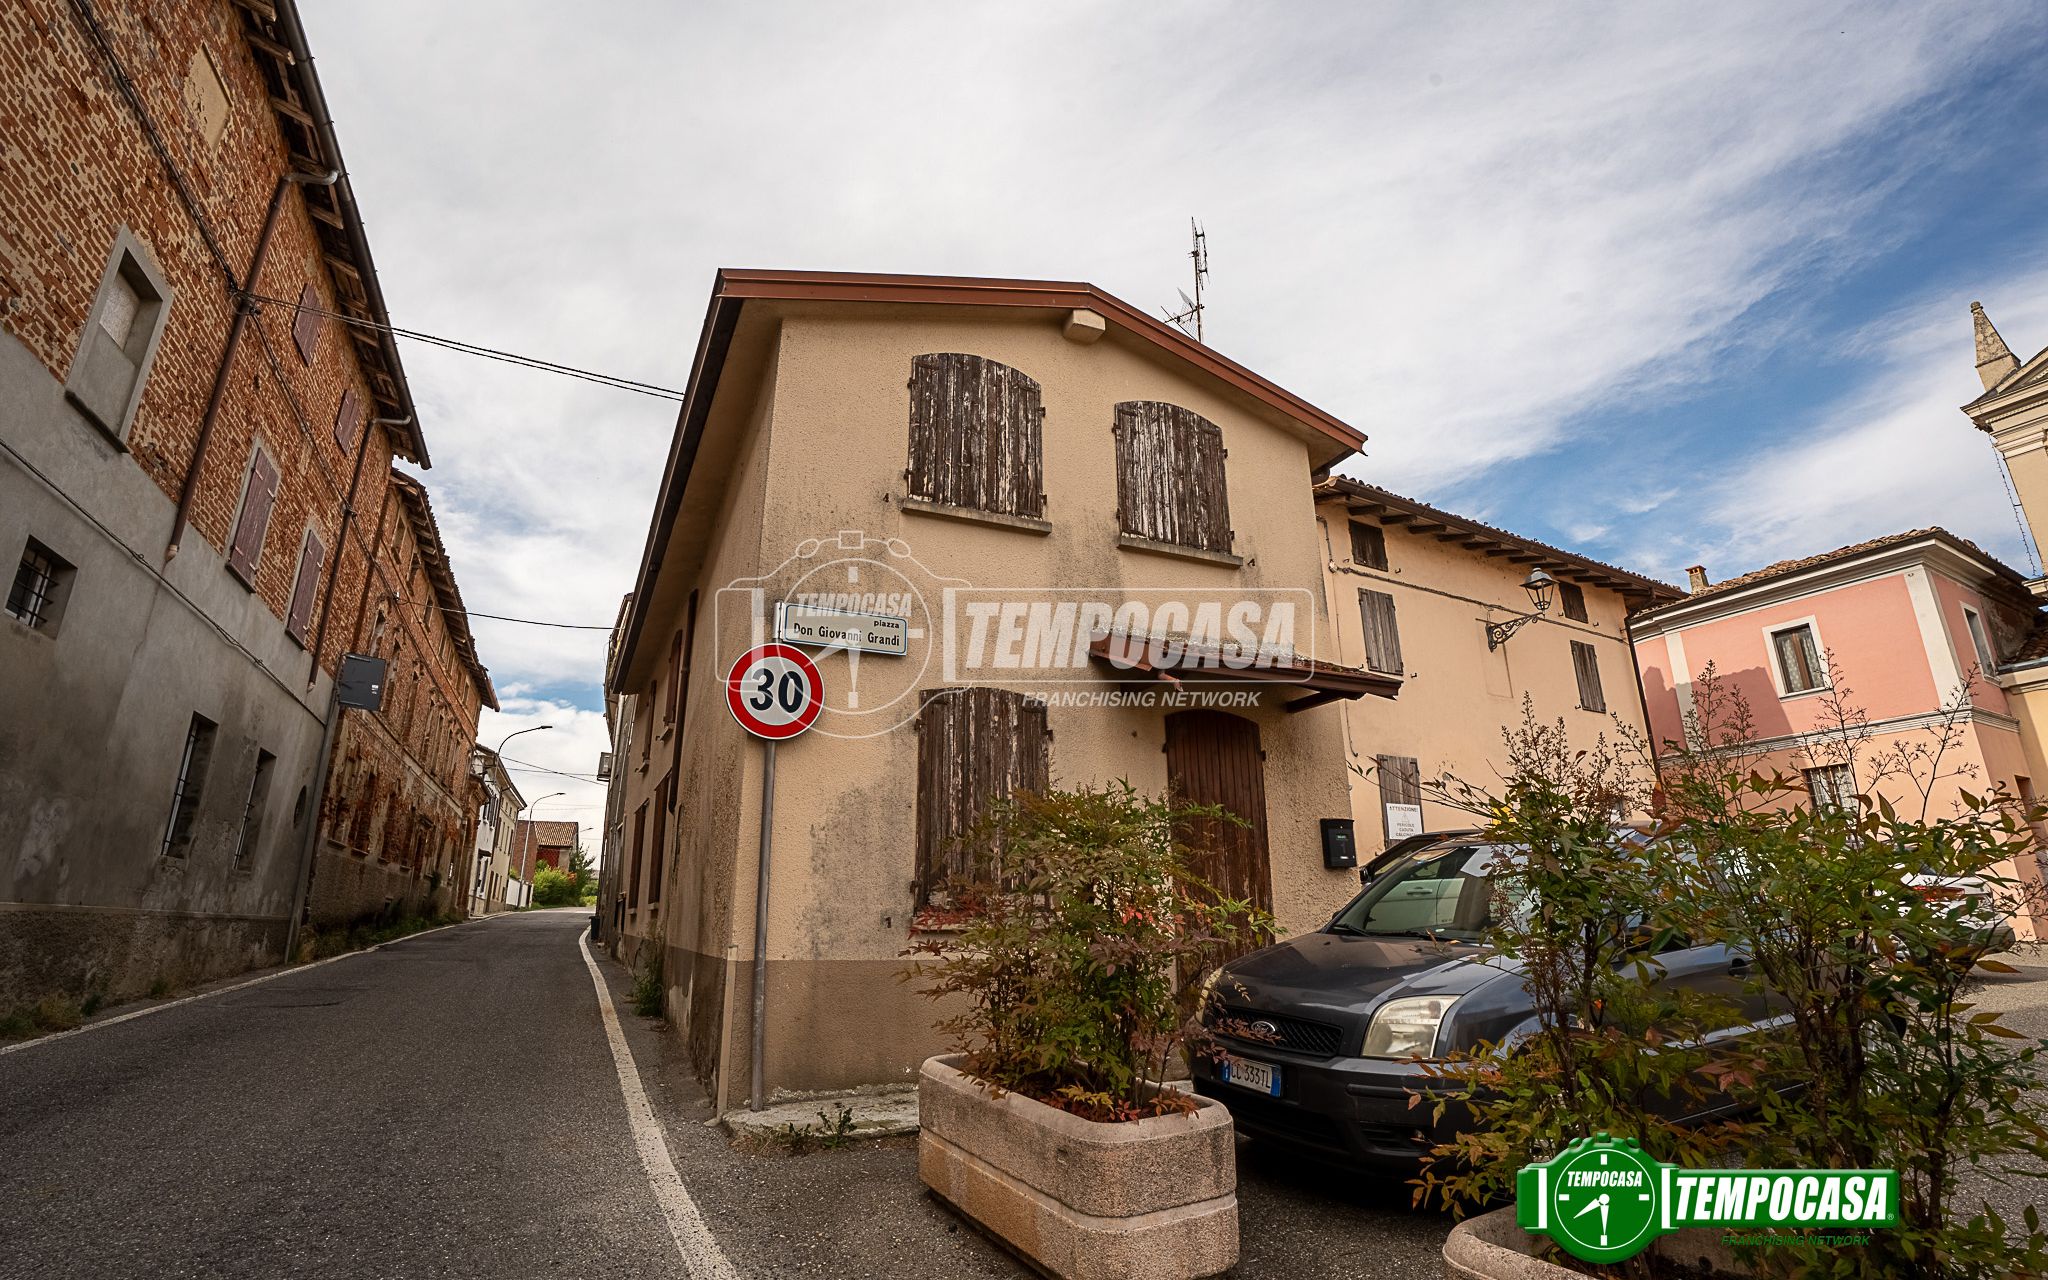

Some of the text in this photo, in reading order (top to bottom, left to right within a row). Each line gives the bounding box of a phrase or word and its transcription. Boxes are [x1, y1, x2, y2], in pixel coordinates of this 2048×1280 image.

[793, 622, 900, 647] Don Giovanni Grandi
[873, 620, 900, 629] piazza
[749, 668, 802, 713] 30
